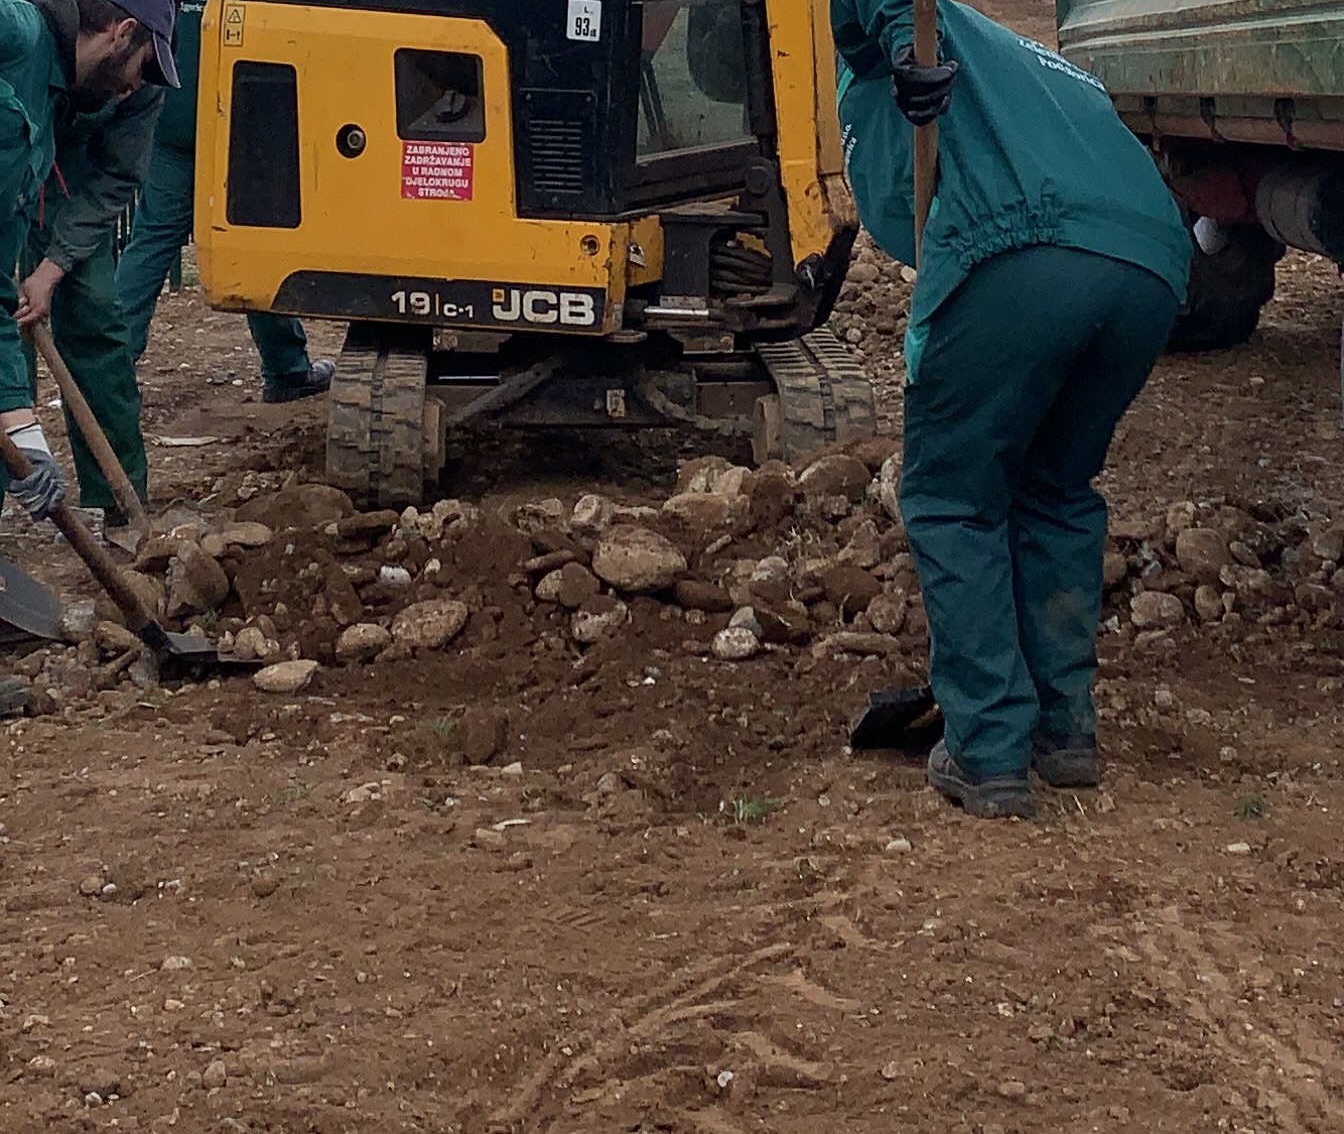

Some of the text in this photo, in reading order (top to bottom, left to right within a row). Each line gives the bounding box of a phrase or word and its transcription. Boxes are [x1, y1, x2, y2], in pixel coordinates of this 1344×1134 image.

[575, 17, 590, 37] 93
[406, 145, 470, 156] ZABRANJENO
[404, 155, 472, 167] ZADRŽAVANJE
[412, 167, 463, 177] U RADNOM
[405, 177, 469, 188] DJELOKRUGU
[391, 291, 431, 315] 19
[492, 288, 595, 326] JCB
